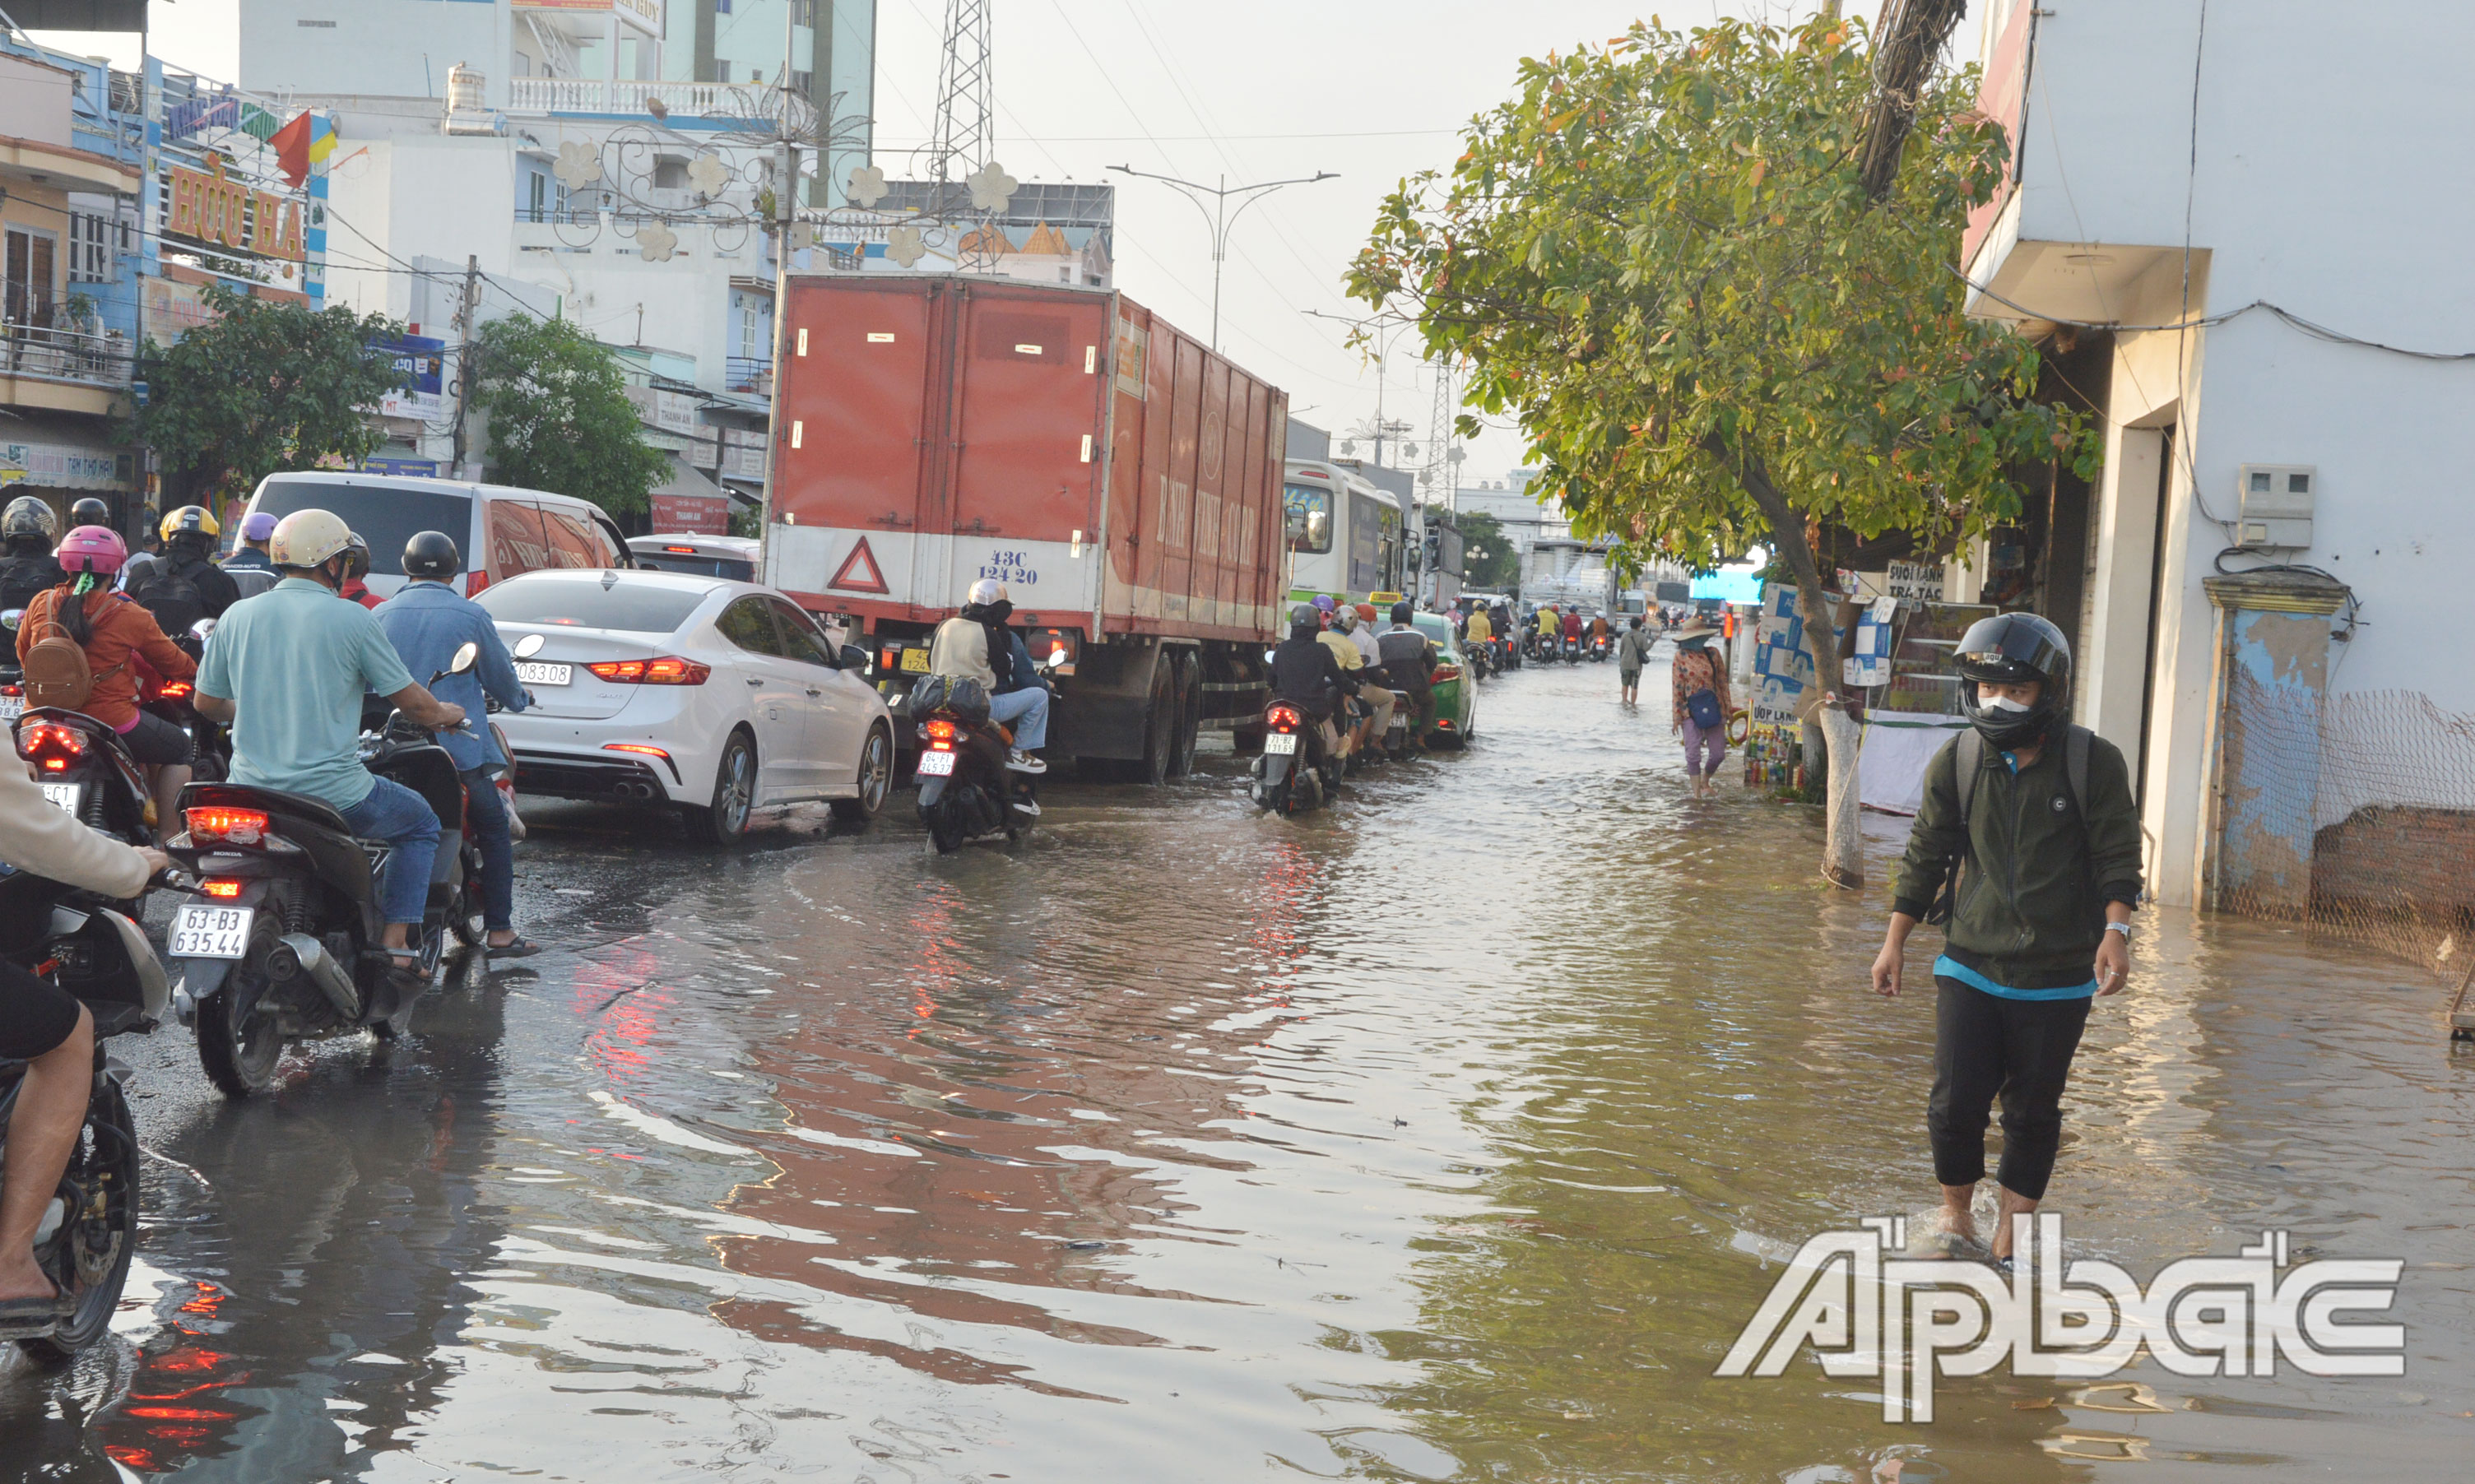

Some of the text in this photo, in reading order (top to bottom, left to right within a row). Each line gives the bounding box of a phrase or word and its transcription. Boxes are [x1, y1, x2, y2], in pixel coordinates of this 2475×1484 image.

[990, 550, 1028, 568] 43C
[187, 909, 240, 931] 63-B3
[174, 931, 241, 955] 635.44
